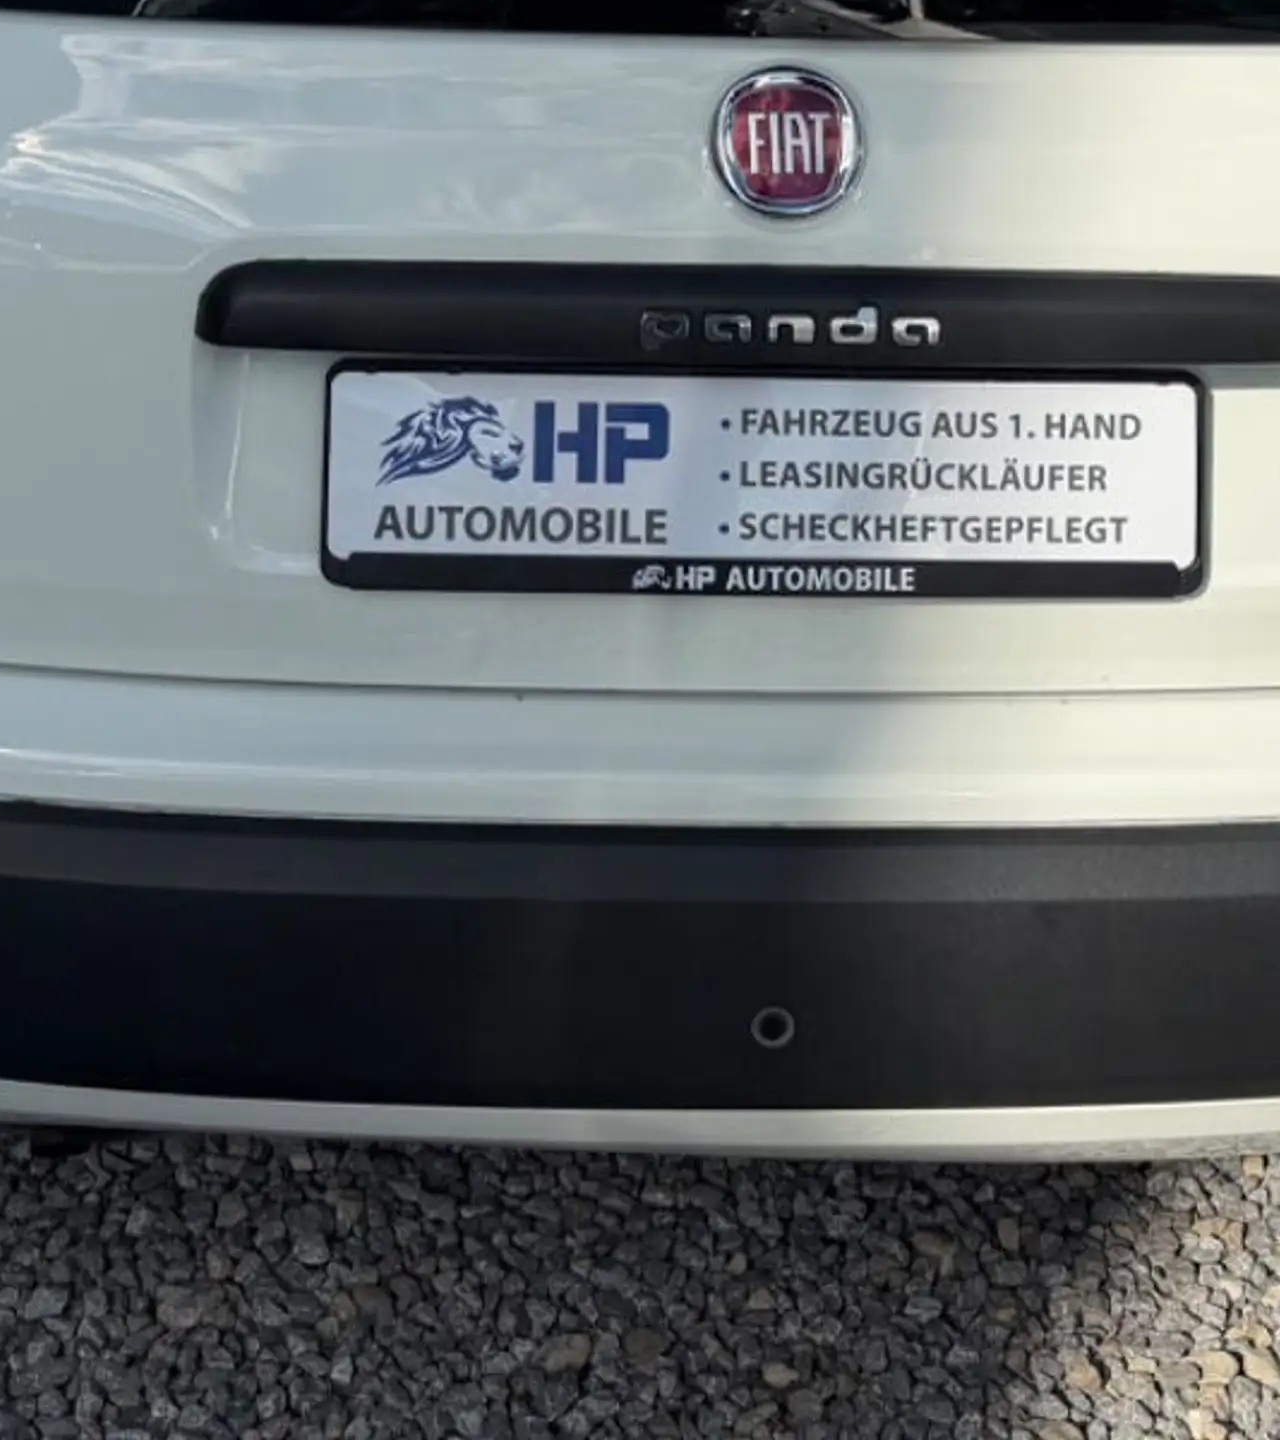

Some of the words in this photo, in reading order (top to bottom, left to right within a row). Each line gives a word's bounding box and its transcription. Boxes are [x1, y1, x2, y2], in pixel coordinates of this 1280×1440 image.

[747, 112, 832, 174] FIAT
[640, 306, 941, 350] panda
[532, 400, 671, 485] HP
[740, 408, 923, 438] FAHRZEUG
[931, 411, 999, 440] AUS
[1008, 413, 1037, 440] 1.
[1045, 413, 1142, 441] HAND
[739, 457, 1109, 492] LEASINGRÜCKLÄUFER
[373, 504, 669, 546] AUTOMOBILE
[738, 512, 1129, 545] SCHECKHEFTGEPFLEGT
[675, 566, 717, 591] HP
[725, 567, 917, 593] AUTOMOBILE
